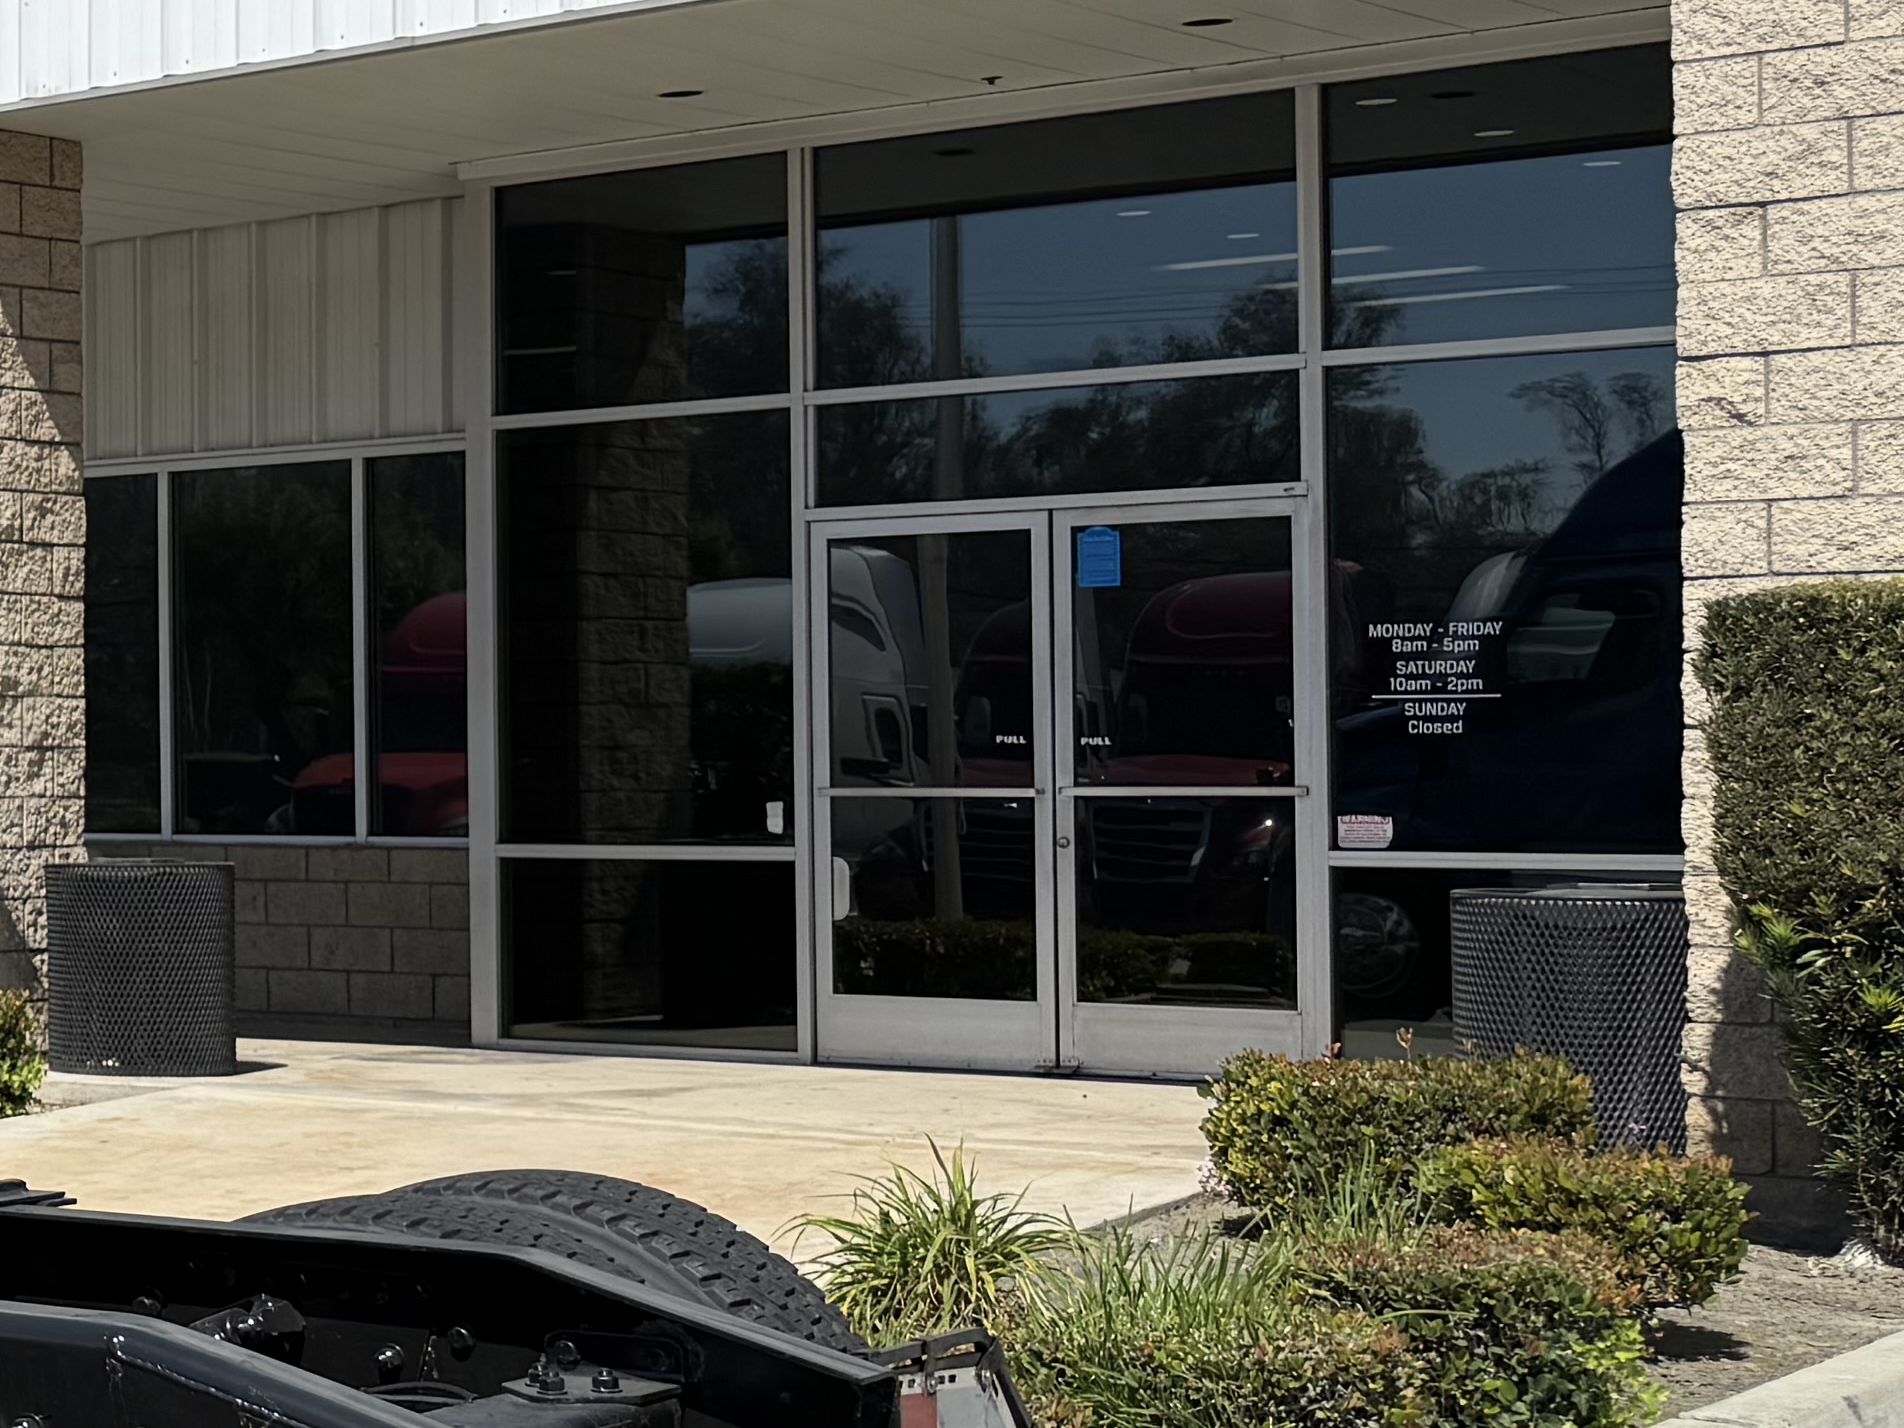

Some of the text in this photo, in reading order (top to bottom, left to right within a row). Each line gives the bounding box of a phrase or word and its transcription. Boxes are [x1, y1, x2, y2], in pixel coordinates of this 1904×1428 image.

[1368, 623, 1433, 638] MONDAY
[1448, 621, 1503, 636] FRIDAY
[1391, 638, 1427, 653] 8am
[1443, 637, 1479, 654] 5pm
[1396, 659, 1476, 675] SATURDAY
[1389, 677, 1431, 691] 10am
[1447, 676, 1483, 693] 2pm
[1404, 702, 1467, 716] SUNDAY
[1408, 719, 1463, 734] Closed
[995, 735, 1027, 744] PULL
[1080, 737, 1112, 746] PULL
